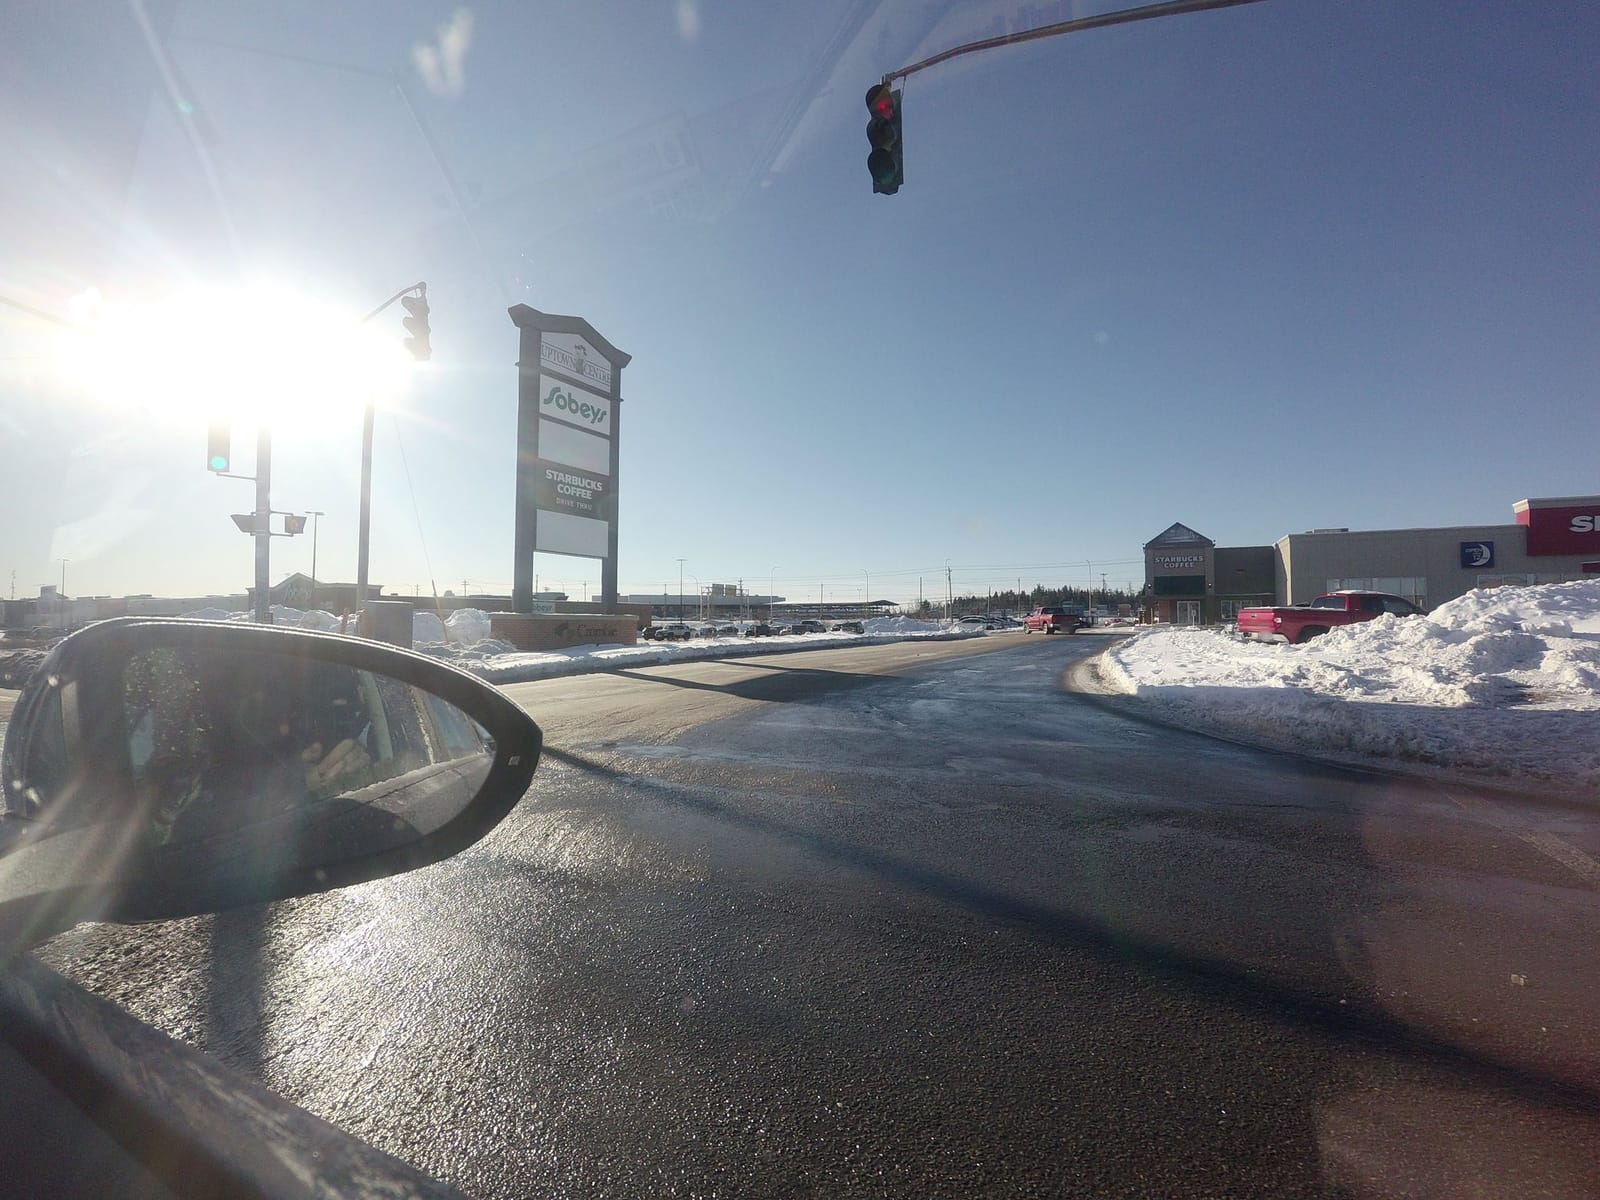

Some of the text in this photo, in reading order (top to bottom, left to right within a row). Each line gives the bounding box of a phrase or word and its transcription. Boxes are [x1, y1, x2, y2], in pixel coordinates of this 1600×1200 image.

[541, 344, 577, 370] UPTOWN
[543, 386, 607, 424] Sobeys
[545, 469, 603, 491] STARBUCKS
[557, 483, 593, 500] COFFEE
[576, 501, 592, 511] THRU
